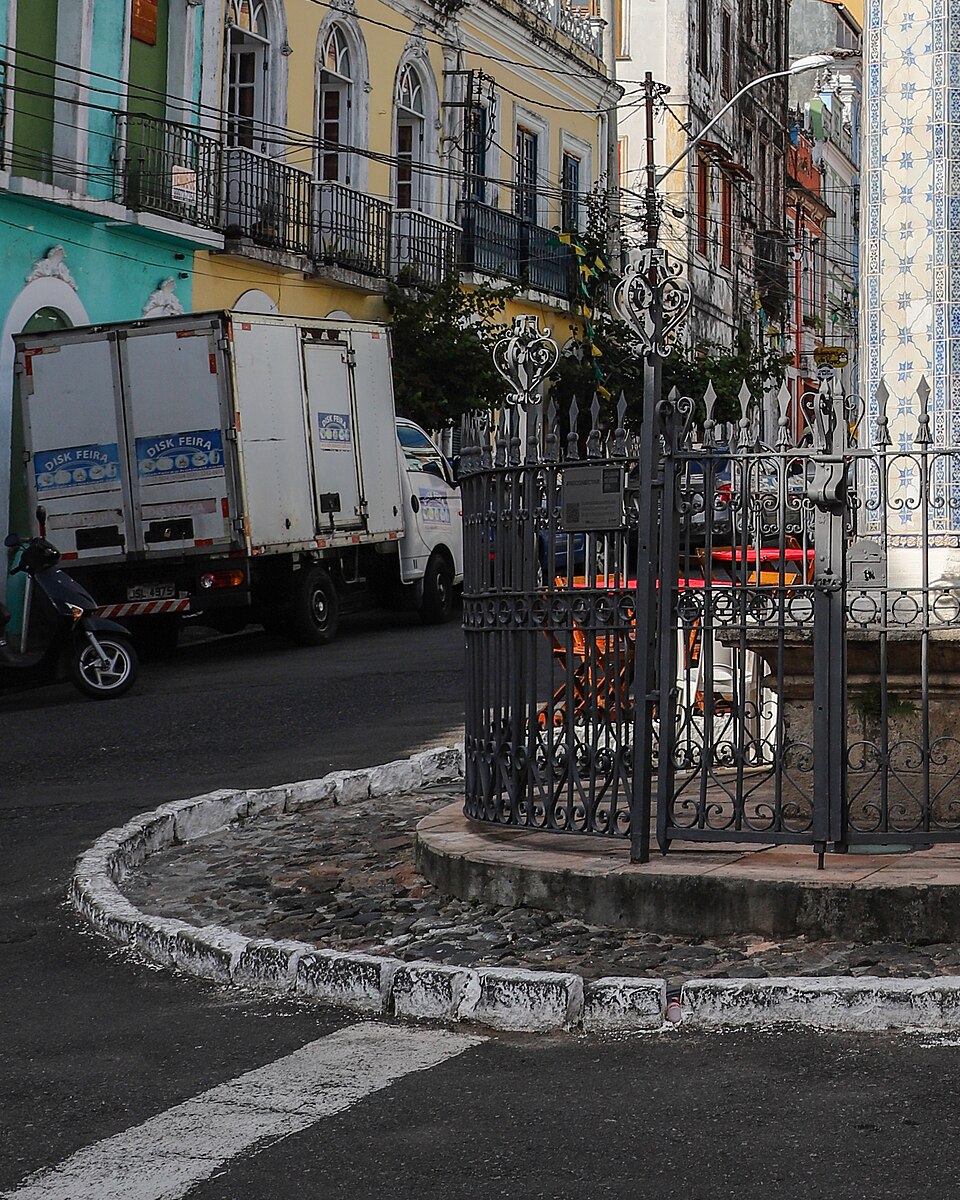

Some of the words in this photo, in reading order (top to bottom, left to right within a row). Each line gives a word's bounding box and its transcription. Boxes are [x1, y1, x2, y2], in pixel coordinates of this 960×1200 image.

[147, 438, 174, 457] DISK
[179, 436, 211, 450] FEIRA
[44, 452, 72, 471] DISK
[76, 449, 108, 463] FEIRA
